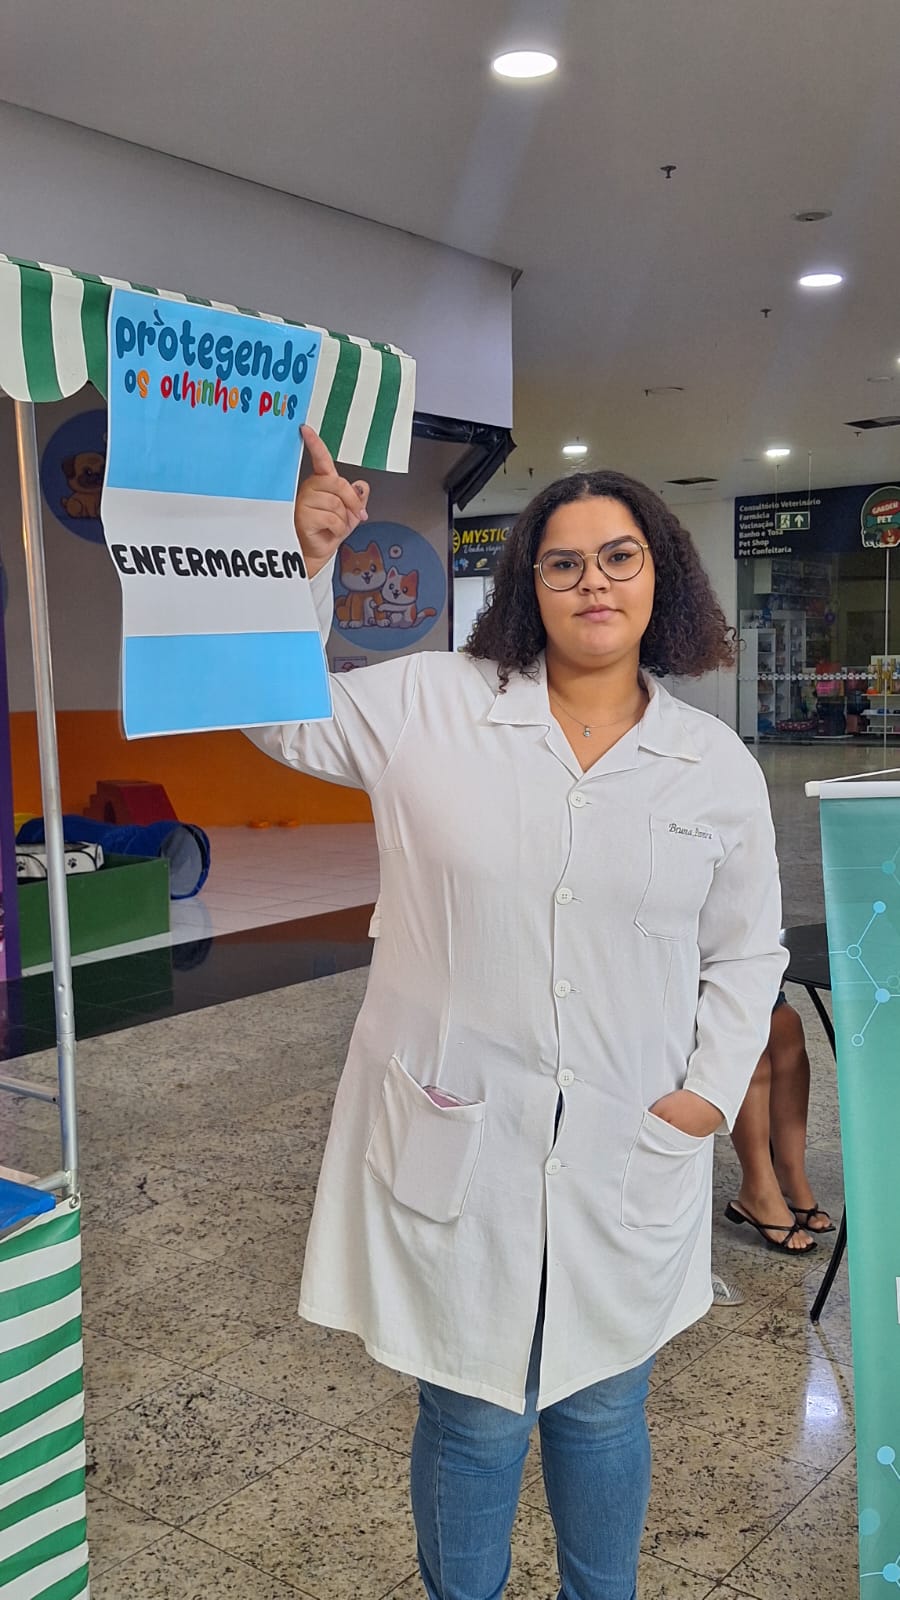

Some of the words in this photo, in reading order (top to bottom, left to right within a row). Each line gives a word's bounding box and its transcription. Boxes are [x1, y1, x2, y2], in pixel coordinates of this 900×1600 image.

[124, 368, 150, 399] os
[160, 371, 252, 413] olhinhos
[258, 391, 298, 420] plis
[739, 502, 780, 513] Consultório
[780, 499, 821, 509] Veterinário
[739, 512, 770, 521] Farmácia
[877, 515, 893, 524] PET
[739, 521, 774, 530] Vacinação
[739, 531, 760, 539] Banho
[752, 539, 769, 547] Shop
[751, 546, 792, 555] Confeitaria
[110, 544, 306, 579] ENFERMAGEM
